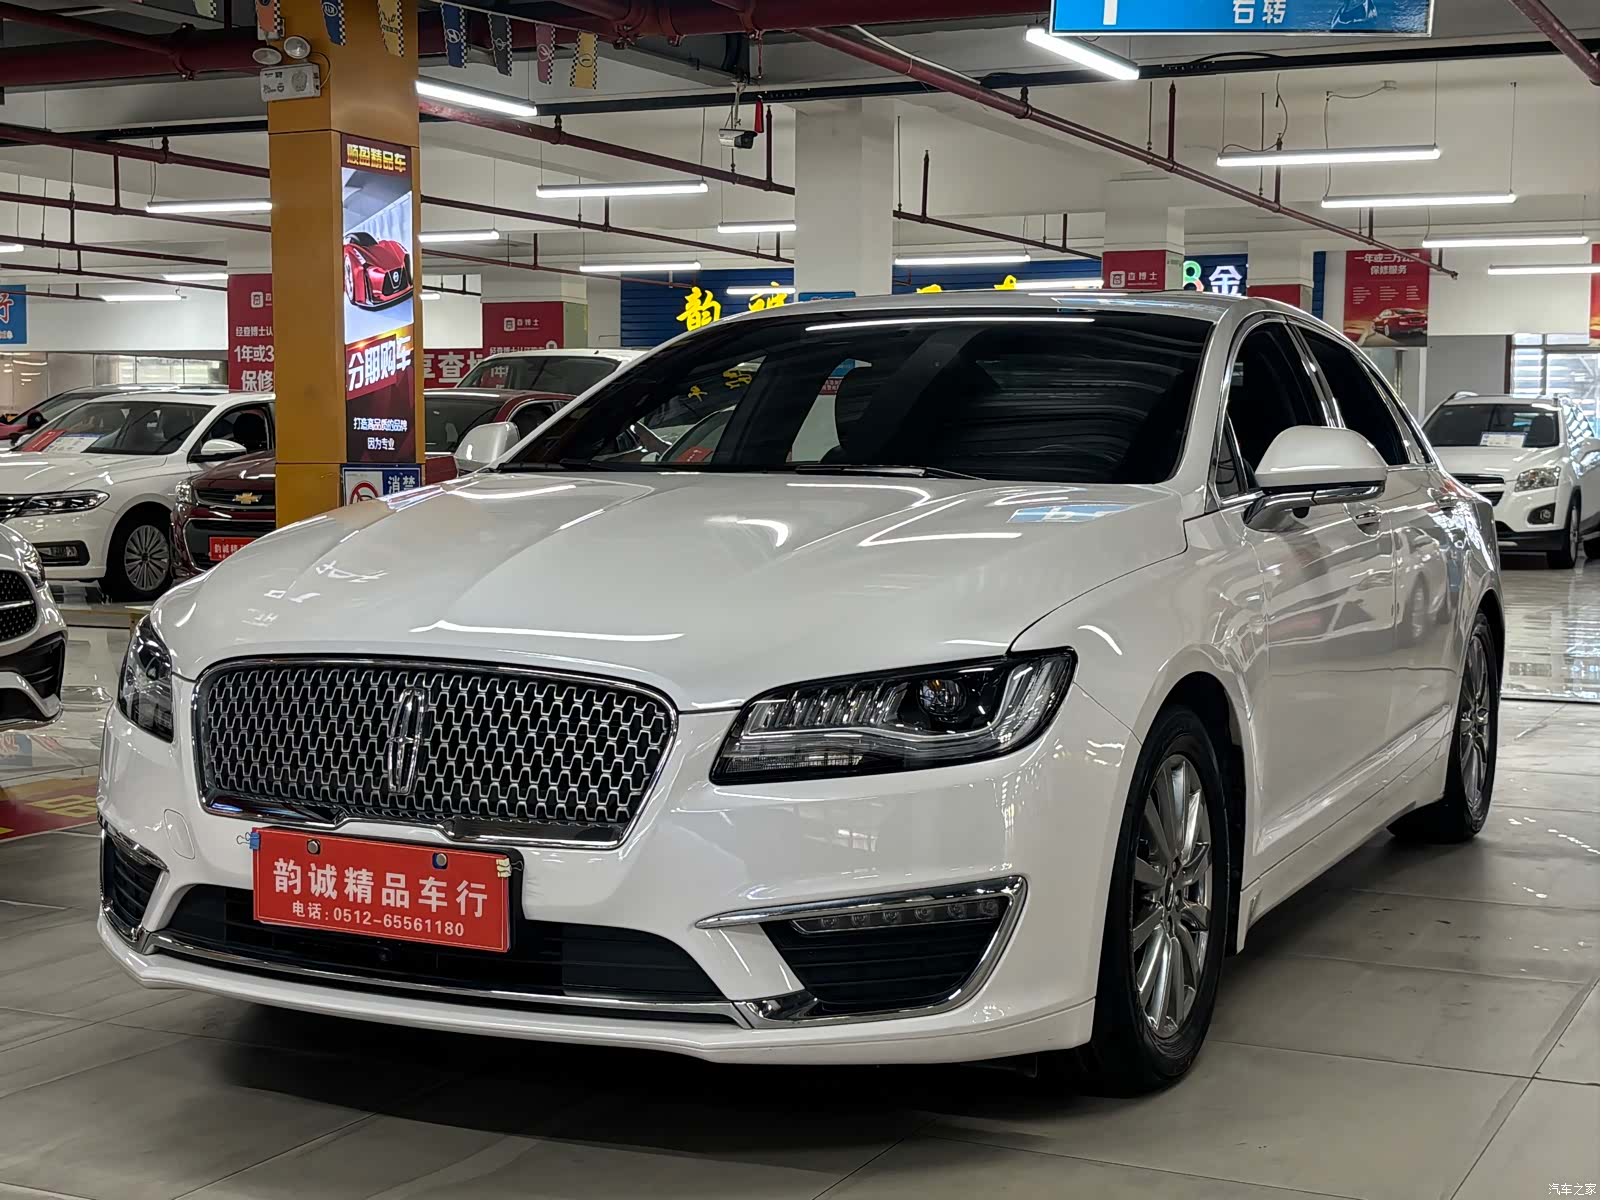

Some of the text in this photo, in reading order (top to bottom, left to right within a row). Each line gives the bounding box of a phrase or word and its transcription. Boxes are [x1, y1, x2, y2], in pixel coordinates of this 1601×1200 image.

[346, 143, 407, 173] 顺盈精品车
[348, 335, 412, 392] 分期购车
[241, 370, 273, 392] 保修
[353, 417, 408, 432] 打造高品质的品牌
[367, 437, 396, 450] 因为专业
[273, 857, 488, 918] 韵诚精品车行
